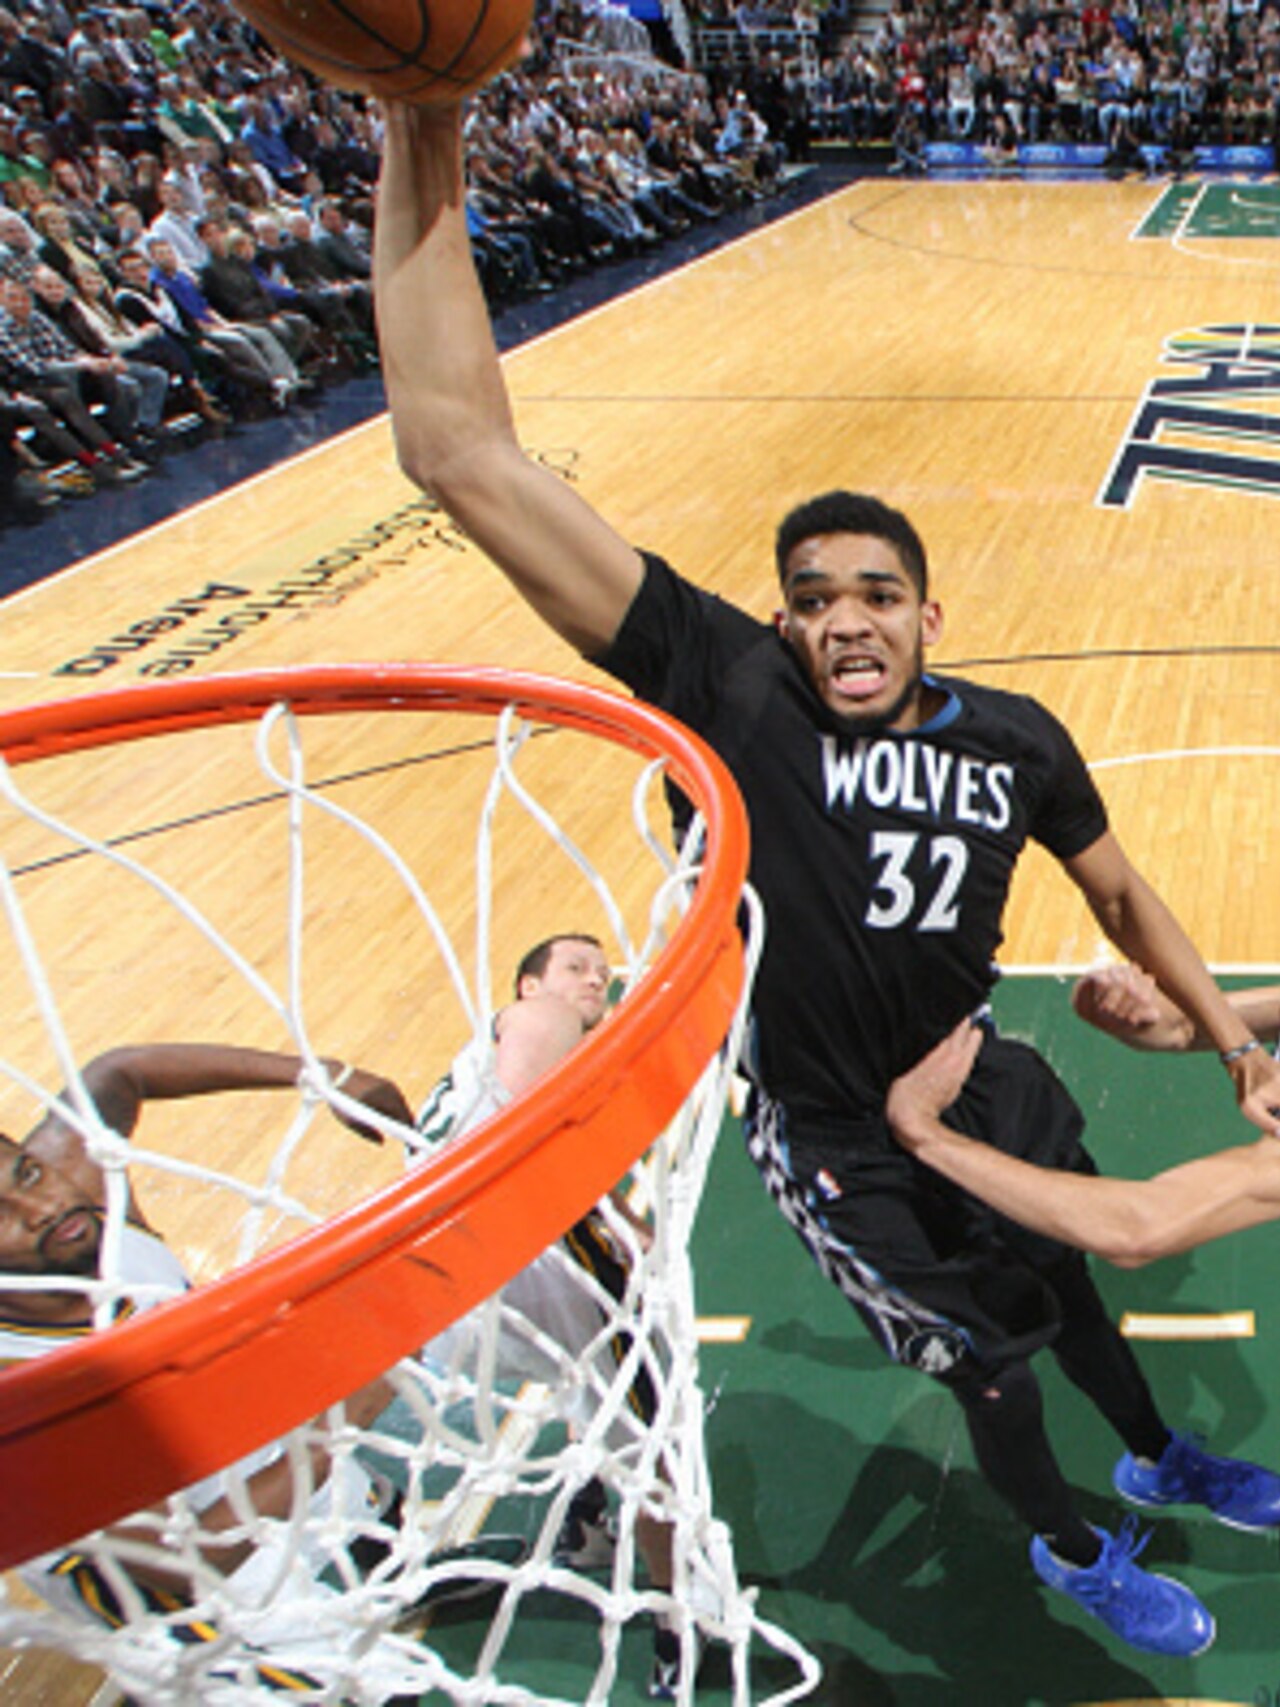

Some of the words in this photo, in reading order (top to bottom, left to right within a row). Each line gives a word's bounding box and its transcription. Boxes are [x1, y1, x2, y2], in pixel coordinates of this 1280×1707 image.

[51, 580, 252, 677] Arena
[819, 733, 1015, 832] WOLVES
[863, 830, 970, 932] 32
